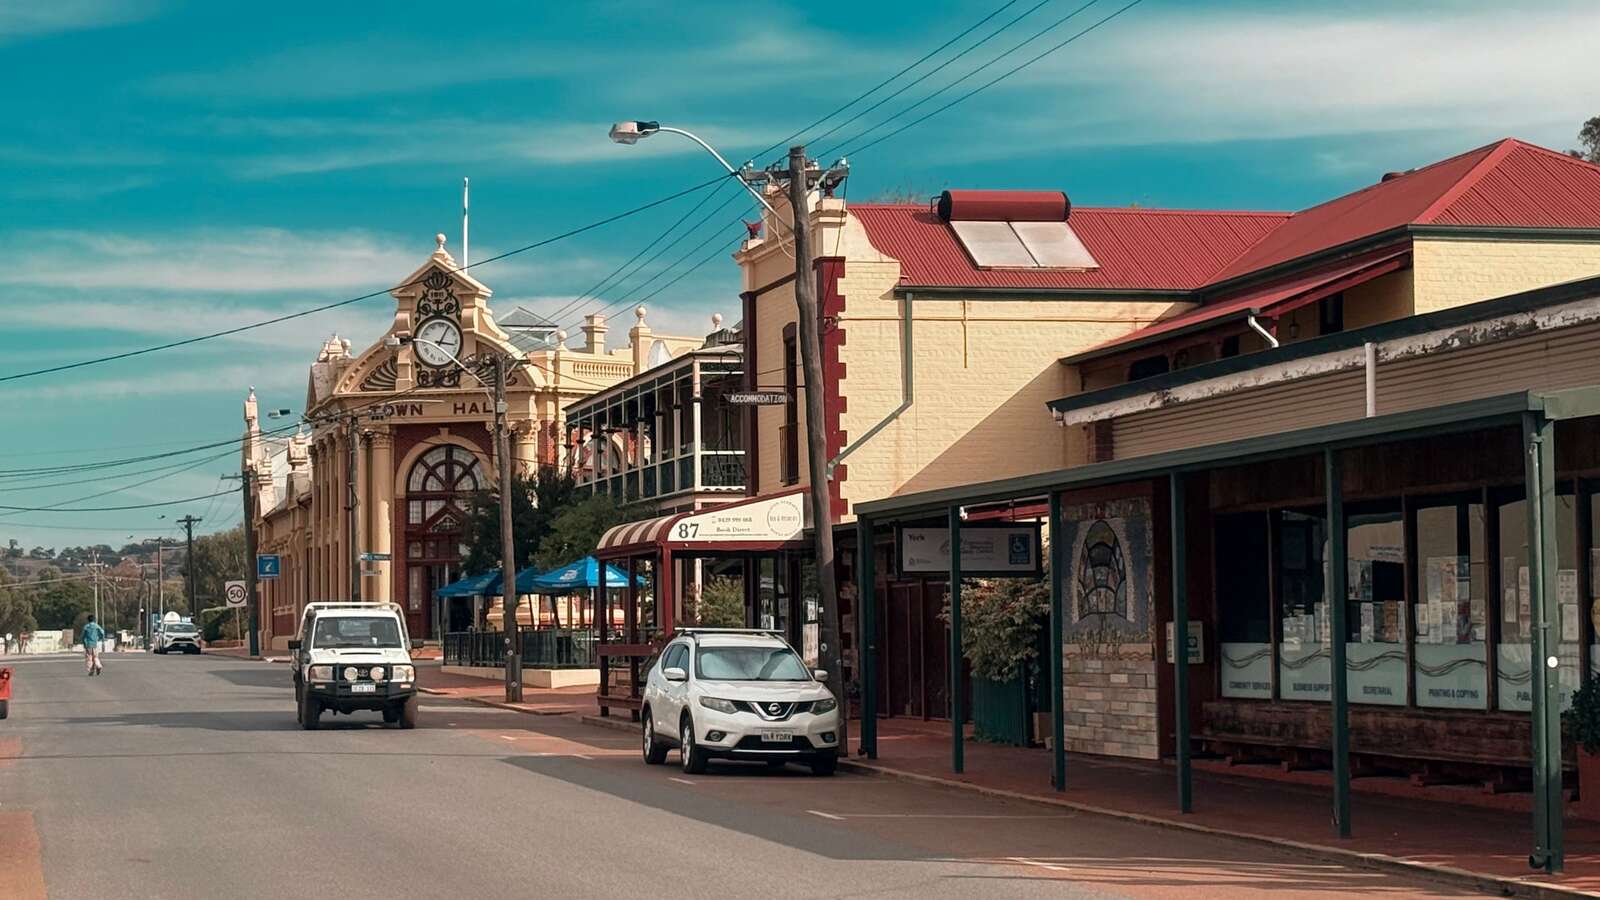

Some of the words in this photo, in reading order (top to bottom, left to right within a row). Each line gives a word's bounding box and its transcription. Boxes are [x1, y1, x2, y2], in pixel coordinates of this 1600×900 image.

[453, 402, 494, 415] HAL
[678, 522, 699, 539] 87
[230, 589, 243, 599] 50
[1428, 688, 1451, 698] PRINTING
[1456, 689, 1478, 699] COPYING
[1516, 691, 1532, 702] PUBL
